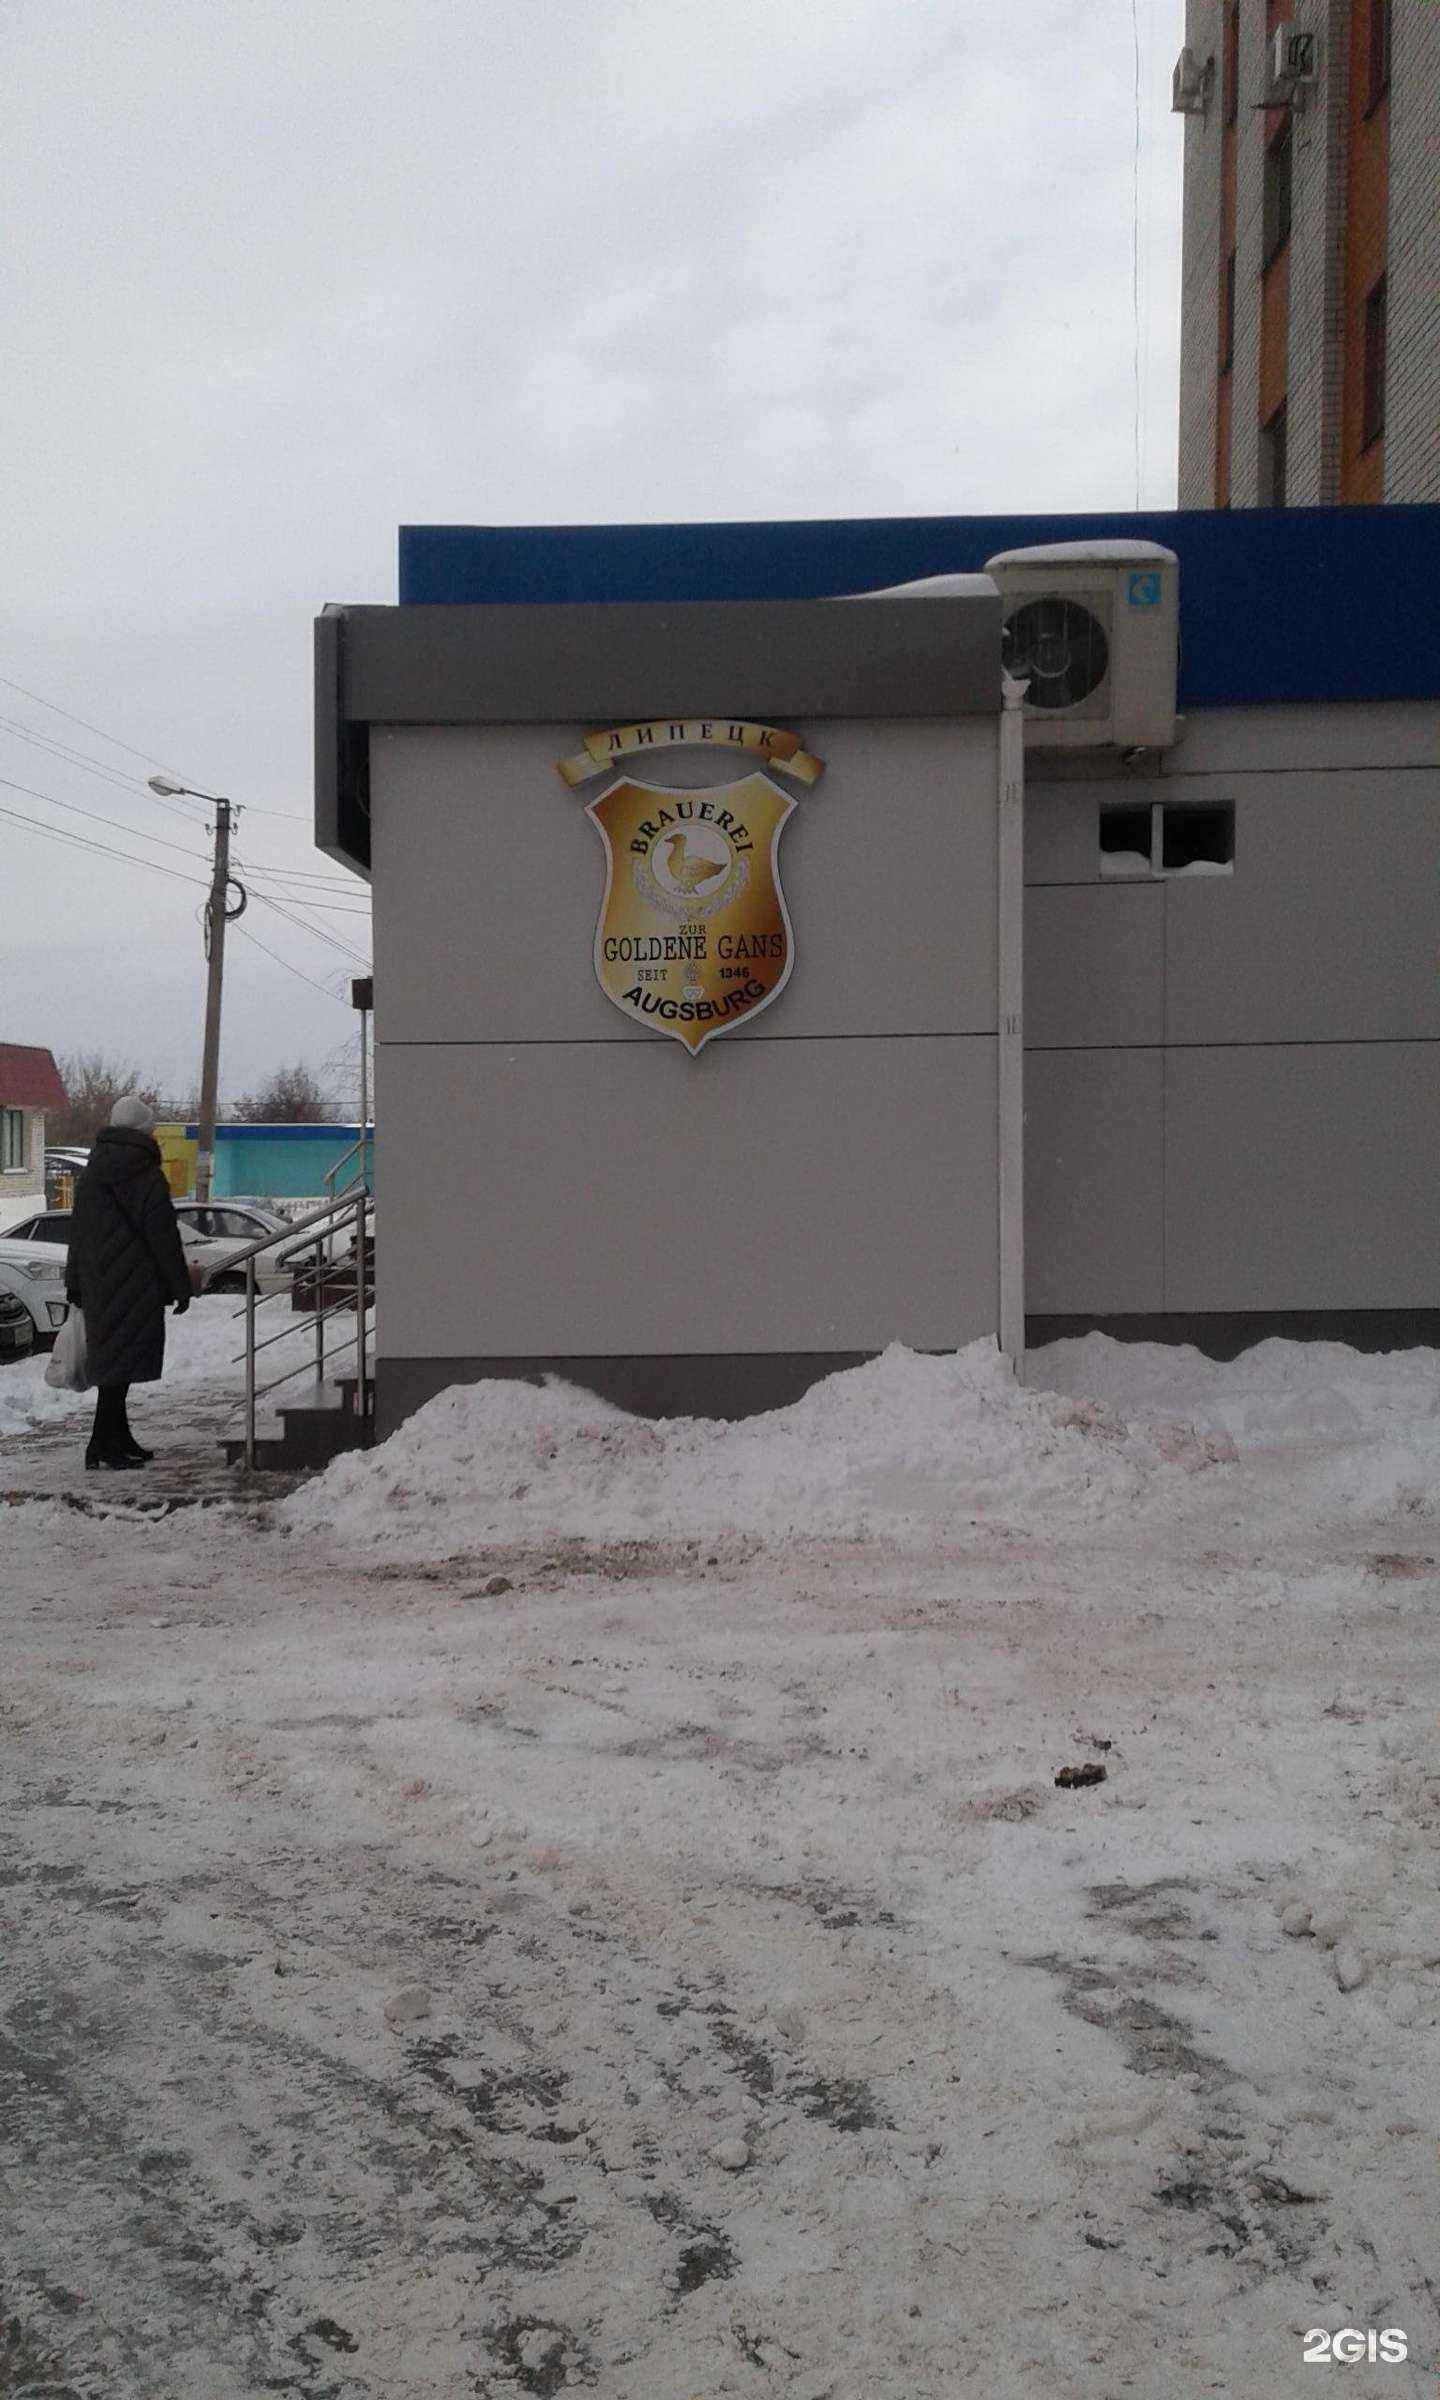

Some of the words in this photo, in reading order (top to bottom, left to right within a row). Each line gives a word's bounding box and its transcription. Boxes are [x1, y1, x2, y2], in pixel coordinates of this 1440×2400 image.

[608, 719, 775, 751] ЛИПЕЦК
[630, 801, 755, 855] BRAUEREI
[678, 925, 706, 935] ZUR
[604, 936, 707, 962] GOLDENE
[718, 934, 783, 959] GANS
[637, 969, 668, 982] SEIT
[622, 979, 766, 1021] AUGSBURG
